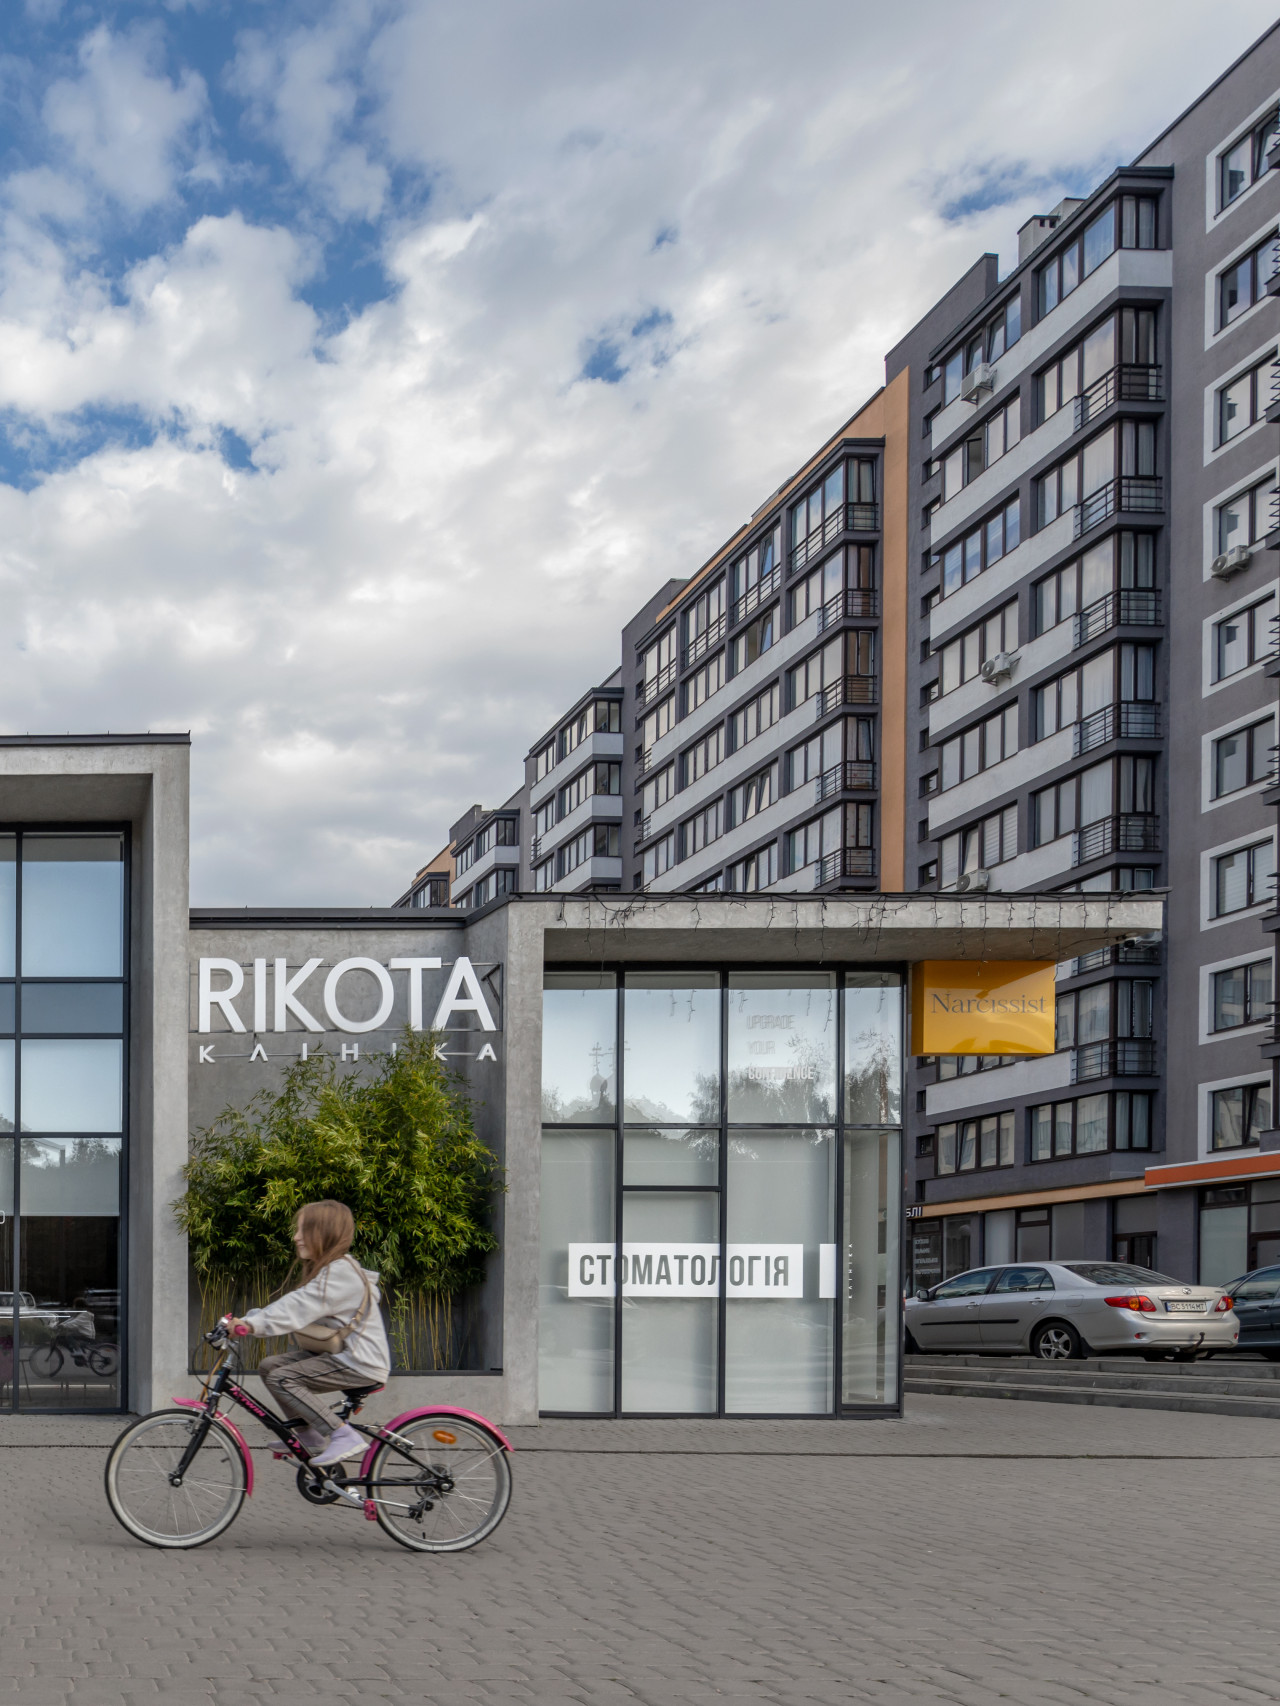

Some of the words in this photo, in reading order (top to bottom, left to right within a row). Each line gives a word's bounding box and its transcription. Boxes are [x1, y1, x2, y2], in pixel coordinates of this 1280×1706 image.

[198, 956, 497, 1034] RIKOTA
[930, 993, 1047, 1014] Narcissist
[746, 1014, 797, 1030] UPGRADE
[746, 1039, 776, 1055] YOUR
[579, 1254, 789, 1287] СТОМАТОЛОГІЯ
